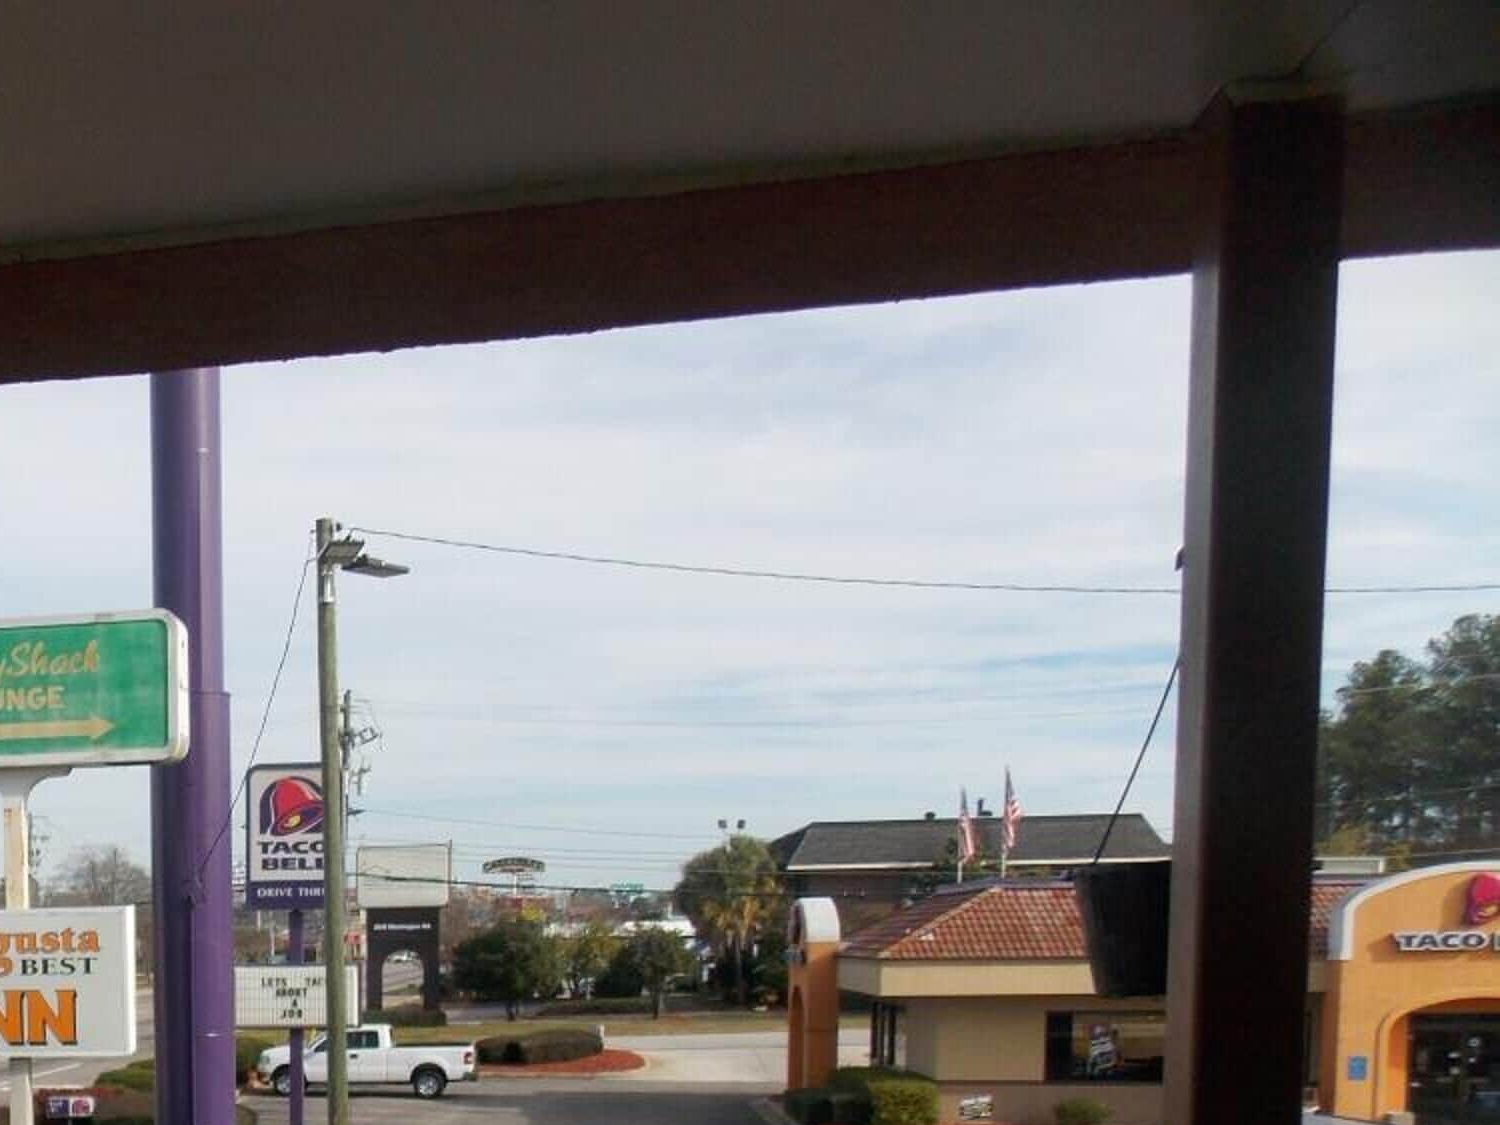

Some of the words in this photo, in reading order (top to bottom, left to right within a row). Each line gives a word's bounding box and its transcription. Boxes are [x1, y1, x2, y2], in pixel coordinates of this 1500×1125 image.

[257, 887, 293, 898] DRIVE
[299, 887, 325, 897] THR
[1395, 931, 1490, 951] TACO
[20, 956, 98, 976] BEST
